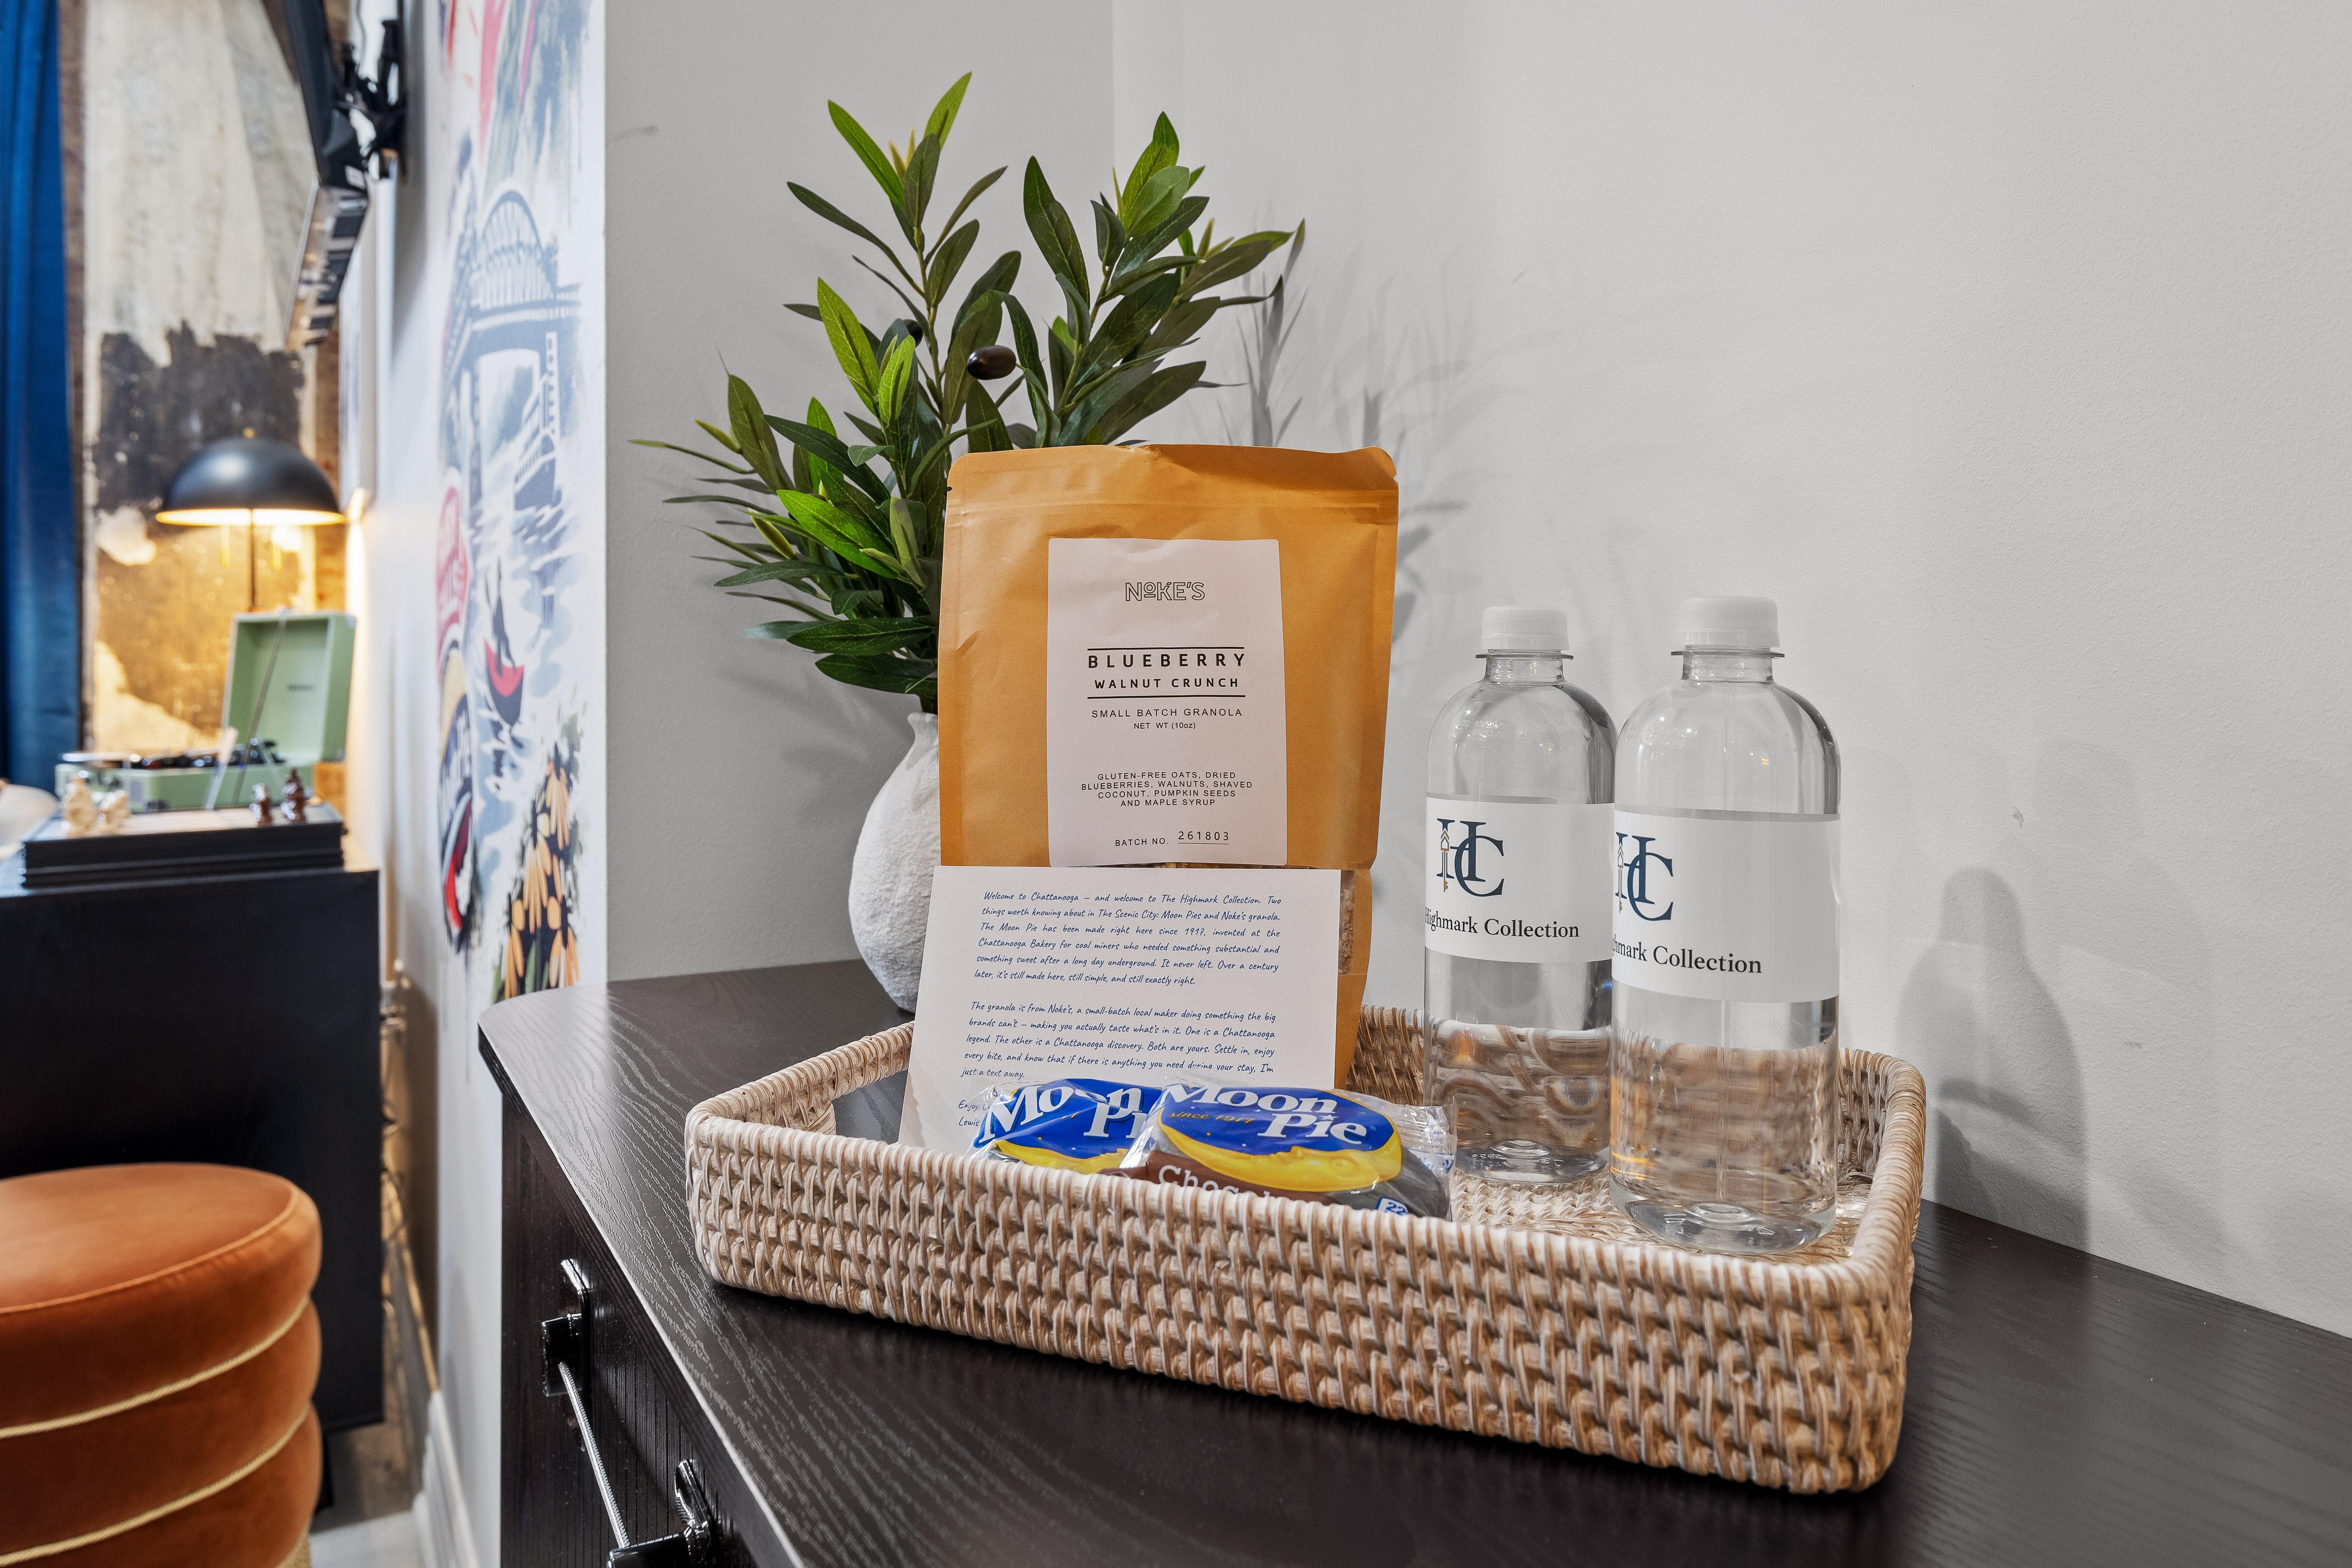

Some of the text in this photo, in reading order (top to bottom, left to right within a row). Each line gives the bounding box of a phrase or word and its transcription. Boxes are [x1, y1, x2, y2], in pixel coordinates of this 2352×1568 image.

[1088, 653, 1245, 668] BLUEBERRY
[1094, 678, 1238, 689] WALNUT CRUNCH
[1091, 708, 1242, 718] SMALL BATCH GRANOLA
[1171, 722, 1196, 730] (10oz)
[1097, 771, 1167, 780] GLUTEN-FREE
[1082, 781, 1153, 791] BLUEBERRIES,
[1098, 790, 1149, 799] COCONUT,
[1115, 838, 1147, 847] BATCH
[1178, 831, 1229, 841] 261803
[984, 891, 1014, 900] Welcome
[1031, 891, 1079, 903] Chattanooga
[1094, 893, 1111, 902] and
[1114, 893, 1143, 902] welcome
[1161, 894, 1176, 903] The
[1180, 894, 1218, 905] Highmark
[1223, 895, 1261, 904] Collection.
[1268, 896, 1281, 905] Two
[982, 907, 1005, 917] things
[1007, 907, 1029, 916] worth
[1031, 907, 1061, 918] knowing
[1063, 908, 1086, 917] about
[1098, 909, 1112, 918] The
[1115, 909, 1138, 918] Scenic
[1142, 909, 1159, 921] City:
[1161, 910, 1183, 919] Moon
[1185, 910, 1202, 919] Pies
[1204, 911, 1220, 920] and
[1248, 912, 1280, 922] granola.
[981, 922, 995, 931] The
[999, 922, 1020, 932] Moon
[1025, 923, 1037, 932] Pie
[1042, 924, 1057, 932] has
[1063, 924, 1079, 933] been
[1085, 925, 1105, 933] made
[1110, 925, 1130, 936] right
[1136, 926, 1153, 934] here
[1185, 927, 1206, 936] 1917,
[1212, 928, 1246, 936] invented
[1267, 929, 1280, 937] the
[1425, 907, 1580, 938] Highmark Collection
[978, 937, 1026, 949] Chattanooga
[1030, 939, 1056, 950] Bakery
[1060, 940, 1072, 949] for
[1075, 940, 1092, 949] coal
[1123, 942, 1139, 950] who
[1143, 942, 1169, 951] needed
[1172, 943, 1211, 954] something
[1215, 944, 1261, 953] substantial
[1264, 945, 1281, 954] and
[976, 954, 1013, 965] something
[1040, 955, 1061, 965] after
[1072, 956, 1087, 967] long
[1091, 957, 1105, 968] day
[1108, 958, 1156, 969] underground.
[1160, 958, 1170, 967] It
[1198, 960, 1213, 969] left.
[1218, 960, 1236, 969] Over
[1249, 962, 1279, 973] century
[1653, 946, 1762, 973] Collection
[974, 969, 993, 979] later,
[1010, 971, 1025, 979] still
[1025, 971, 1045, 980] made
[1047, 972, 1065, 982] here,
[1068, 973, 1084, 981] still
[1084, 973, 1108, 984] simple,
[1111, 974, 1127, 983] and
[1128, 975, 1144, 983] still
[1145, 975, 1172, 986] exactly
[1174, 976, 1195, 987] right.
[971, 1001, 985, 1010] The
[987, 1003, 1016, 1013] granola
[1027, 1003, 1045, 1013] from
[1085, 1006, 1131, 1015] small-batch
[1133, 1007, 1153, 1016] local
[1154, 1008, 1179, 1017] maker
[1181, 1009, 1201, 1021] doing
[1205, 1011, 1244, 1022] something
[1247, 1011, 1261, 1020] the
[1264, 1012, 1276, 1024] big
[969, 1017, 996, 1027] brands
[1030, 1020, 1057, 1032] making
[1058, 1024, 1073, 1032] you
[1076, 1022, 1106, 1034] actually
[1109, 1024, 1130, 1032] taste
[1185, 1026, 1200, 1035] One
[1223, 1027, 1275, 1040] Chattanooga
[966, 1034, 991, 1045] legend.
[995, 1035, 1009, 1044] The
[1012, 1036, 1033, 1045] other
[1054, 1037, 1104, 1050] Chattanooga
[1107, 1040, 1143, 1052] discovery.
[1147, 1041, 1167, 1051] Both
[1185, 1046, 1210, 1054] yours.
[1214, 1044, 1238, 1054] Settle
[1240, 1046, 1250, 1056] in,
[1254, 1047, 1275, 1058] enjoy
[1151, 1084, 1337, 1116] Moon
[959, 1116, 980, 1127] Lewis
[1258, 1113, 1367, 1144] Pie
